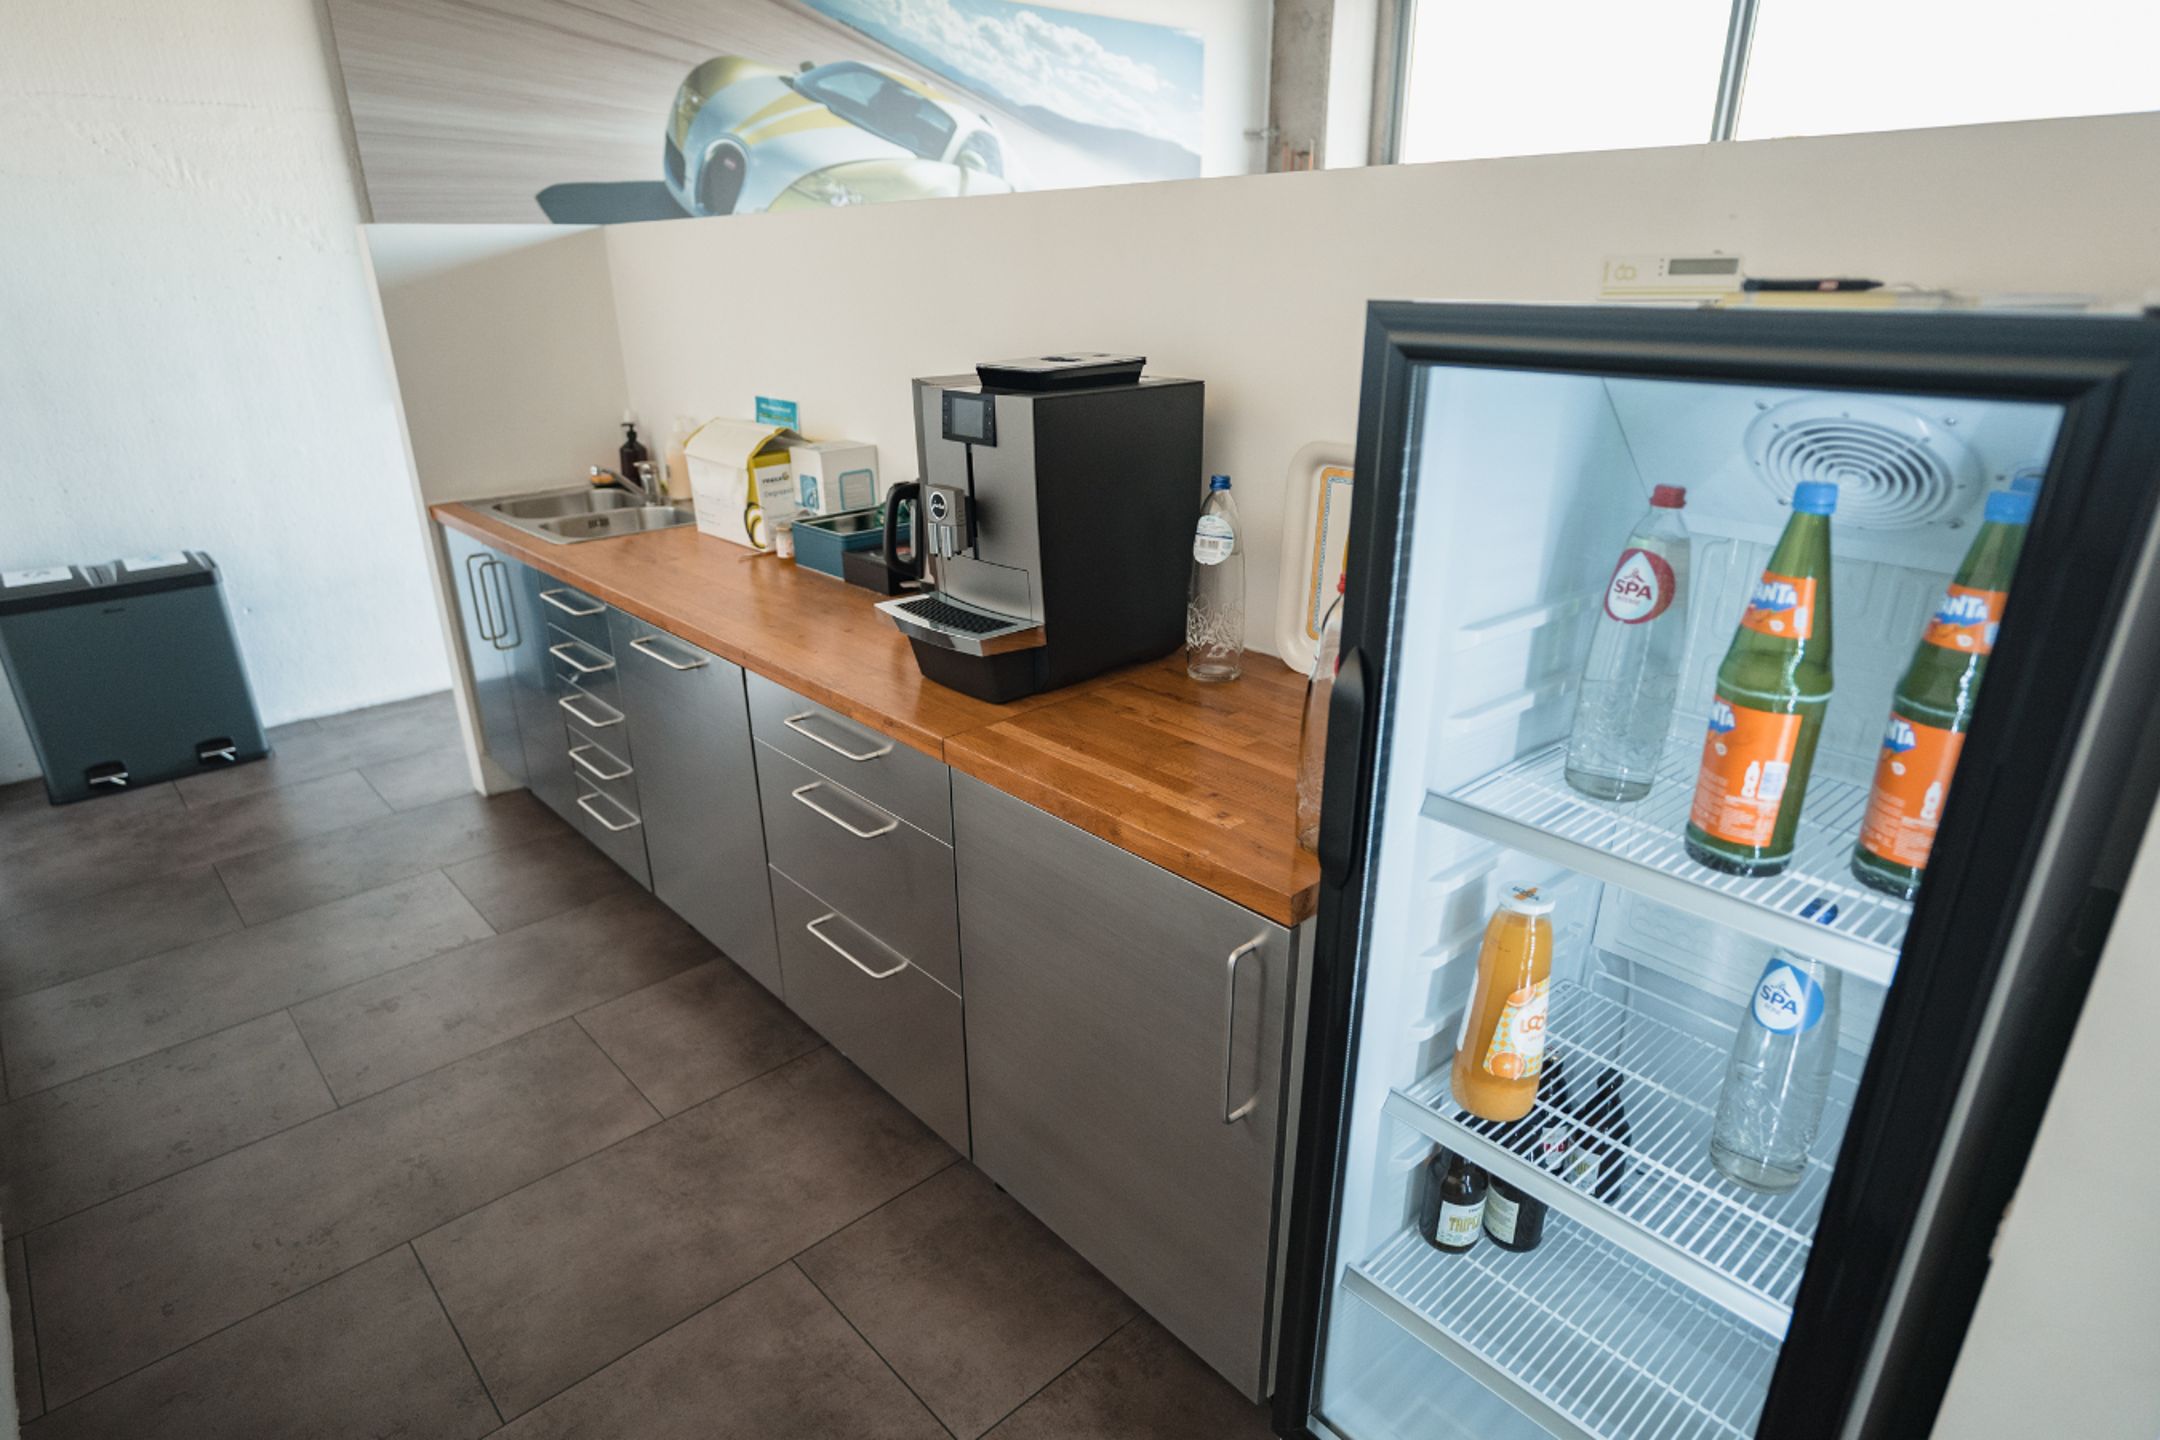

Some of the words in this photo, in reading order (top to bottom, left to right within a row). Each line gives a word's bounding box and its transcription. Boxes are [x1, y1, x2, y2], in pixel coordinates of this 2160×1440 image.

[1614, 579, 1652, 600] SPA
[1752, 582, 1798, 606] ANTA
[1941, 595, 1988, 619] ANTA
[1760, 985, 1797, 1015] SPA
